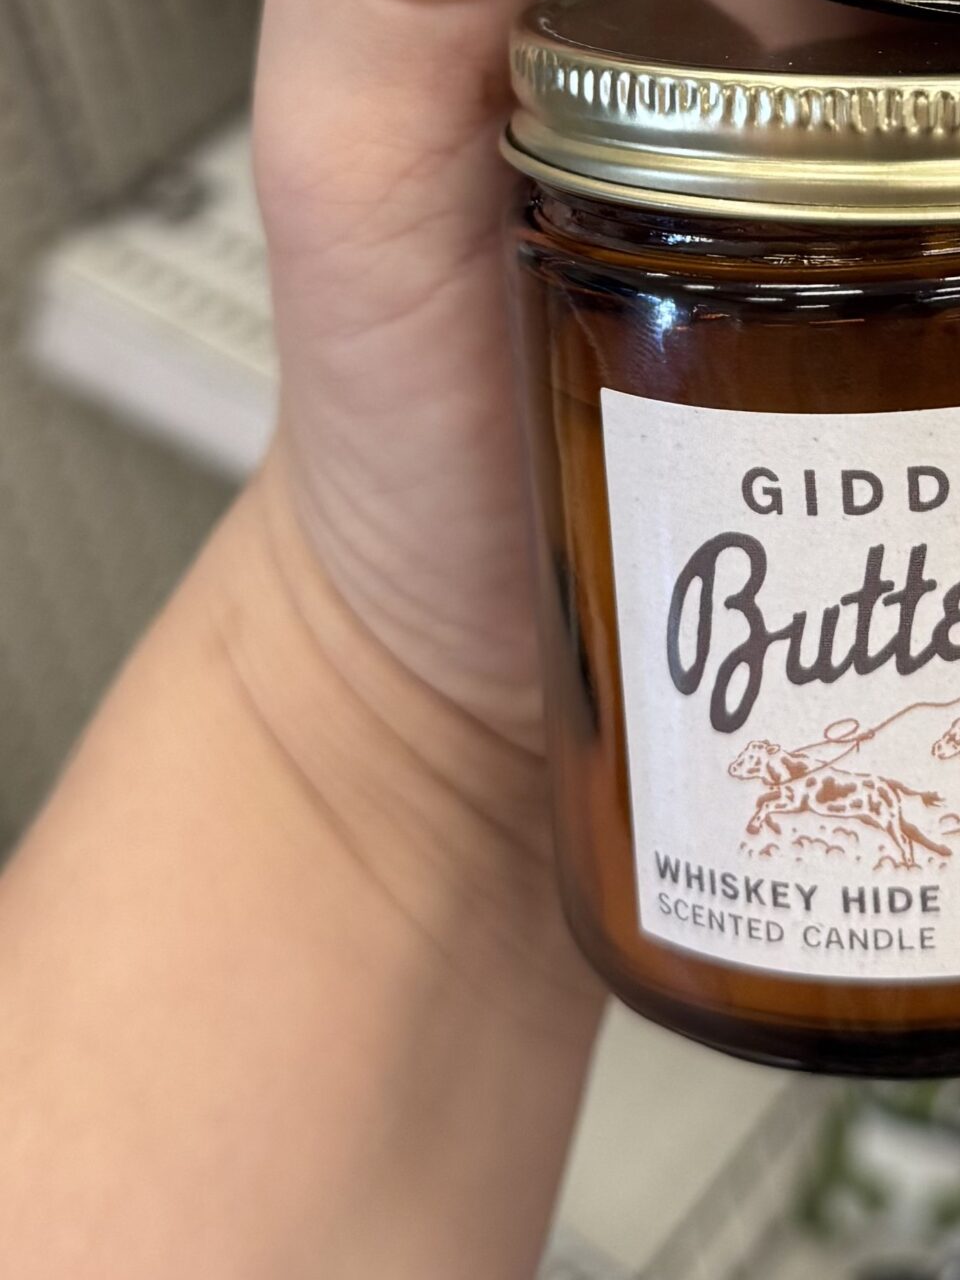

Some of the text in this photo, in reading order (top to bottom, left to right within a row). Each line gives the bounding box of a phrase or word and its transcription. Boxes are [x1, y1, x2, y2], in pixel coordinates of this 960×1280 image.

[655, 851, 941, 913] WHISKEY HIDE
[658, 893, 936, 950] SCENTED CANDLE
